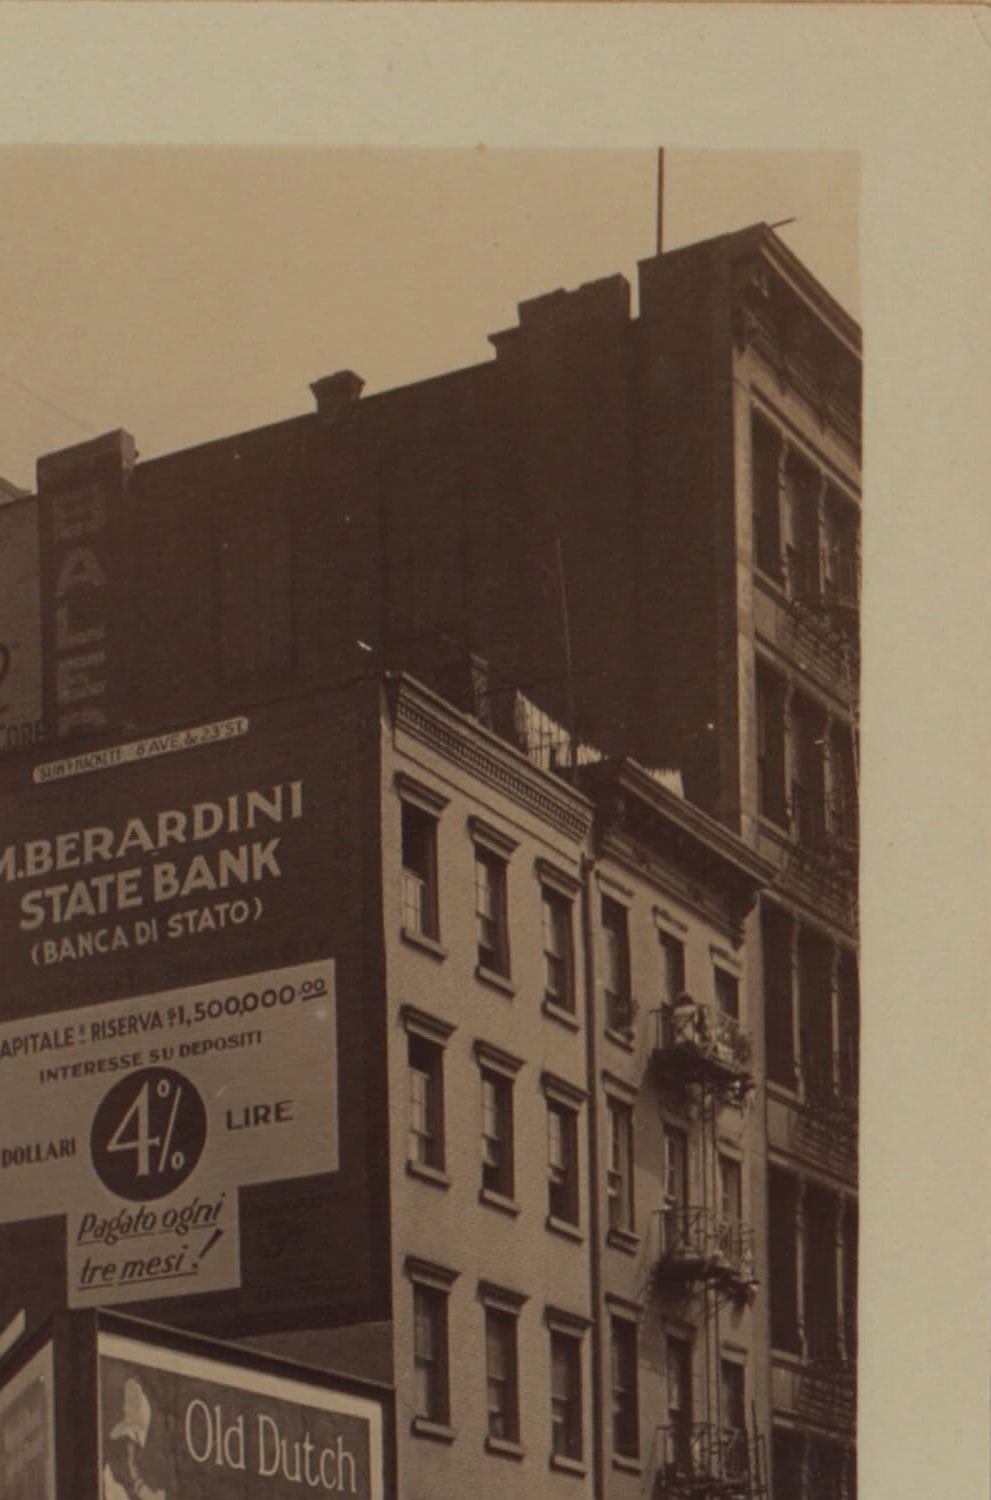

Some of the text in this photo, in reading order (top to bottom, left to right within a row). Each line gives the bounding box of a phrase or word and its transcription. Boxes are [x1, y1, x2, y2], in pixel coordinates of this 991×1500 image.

[149, 735, 179, 753] AVE
[19, 837, 282, 931] STATE BANK
[31, 896, 264, 966] (BANCA DI STATO)
[90, 1010, 163, 1042] RISERVA
[39, 1030, 262, 1084] INTERESSE SU DEPOSITI
[1, 1078, 294, 1177] DOLLARI 4% LIRE
[161, 1192, 227, 1237] ogni
[79, 1257, 115, 1285] tre
[184, 1398, 357, 1493] Old Dutch
